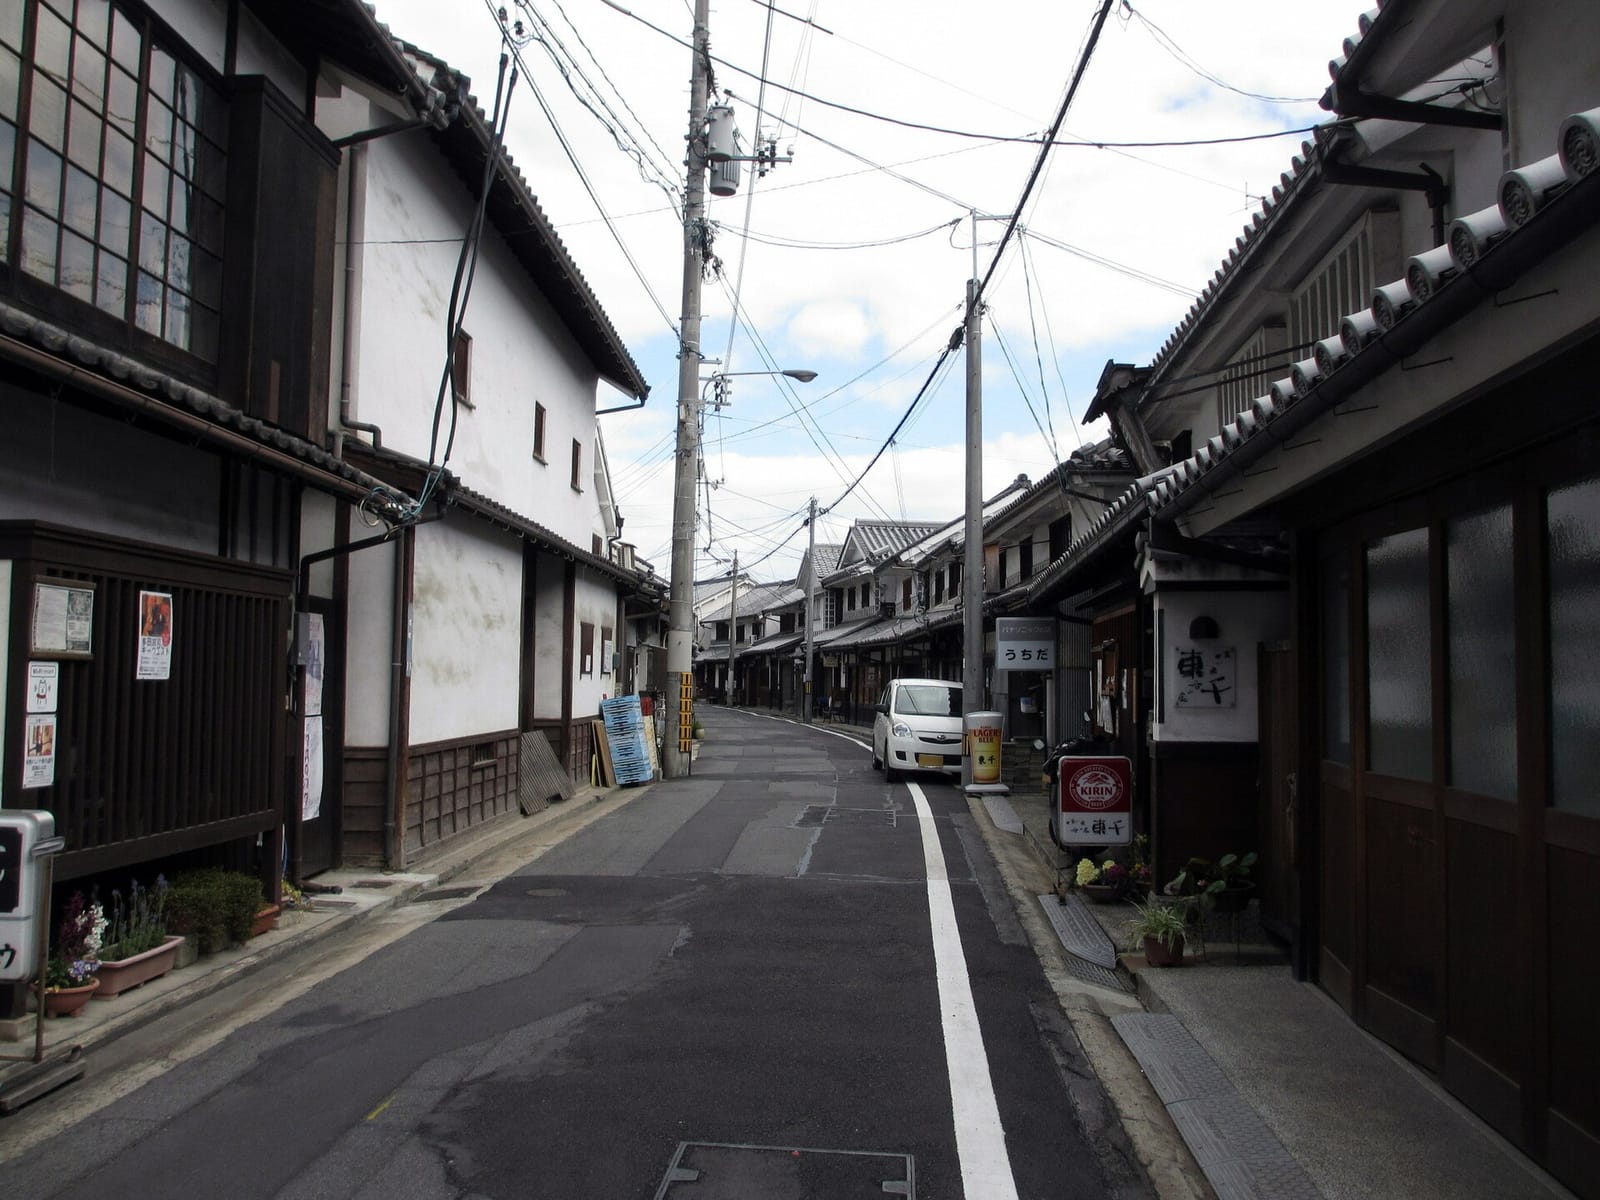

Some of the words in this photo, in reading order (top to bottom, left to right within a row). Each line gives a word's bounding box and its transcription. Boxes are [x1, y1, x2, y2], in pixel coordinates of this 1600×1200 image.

[1005, 648, 1049, 661] うちだ
[973, 728, 998, 737] LAGER
[1080, 786, 1113, 796] KIRIN
